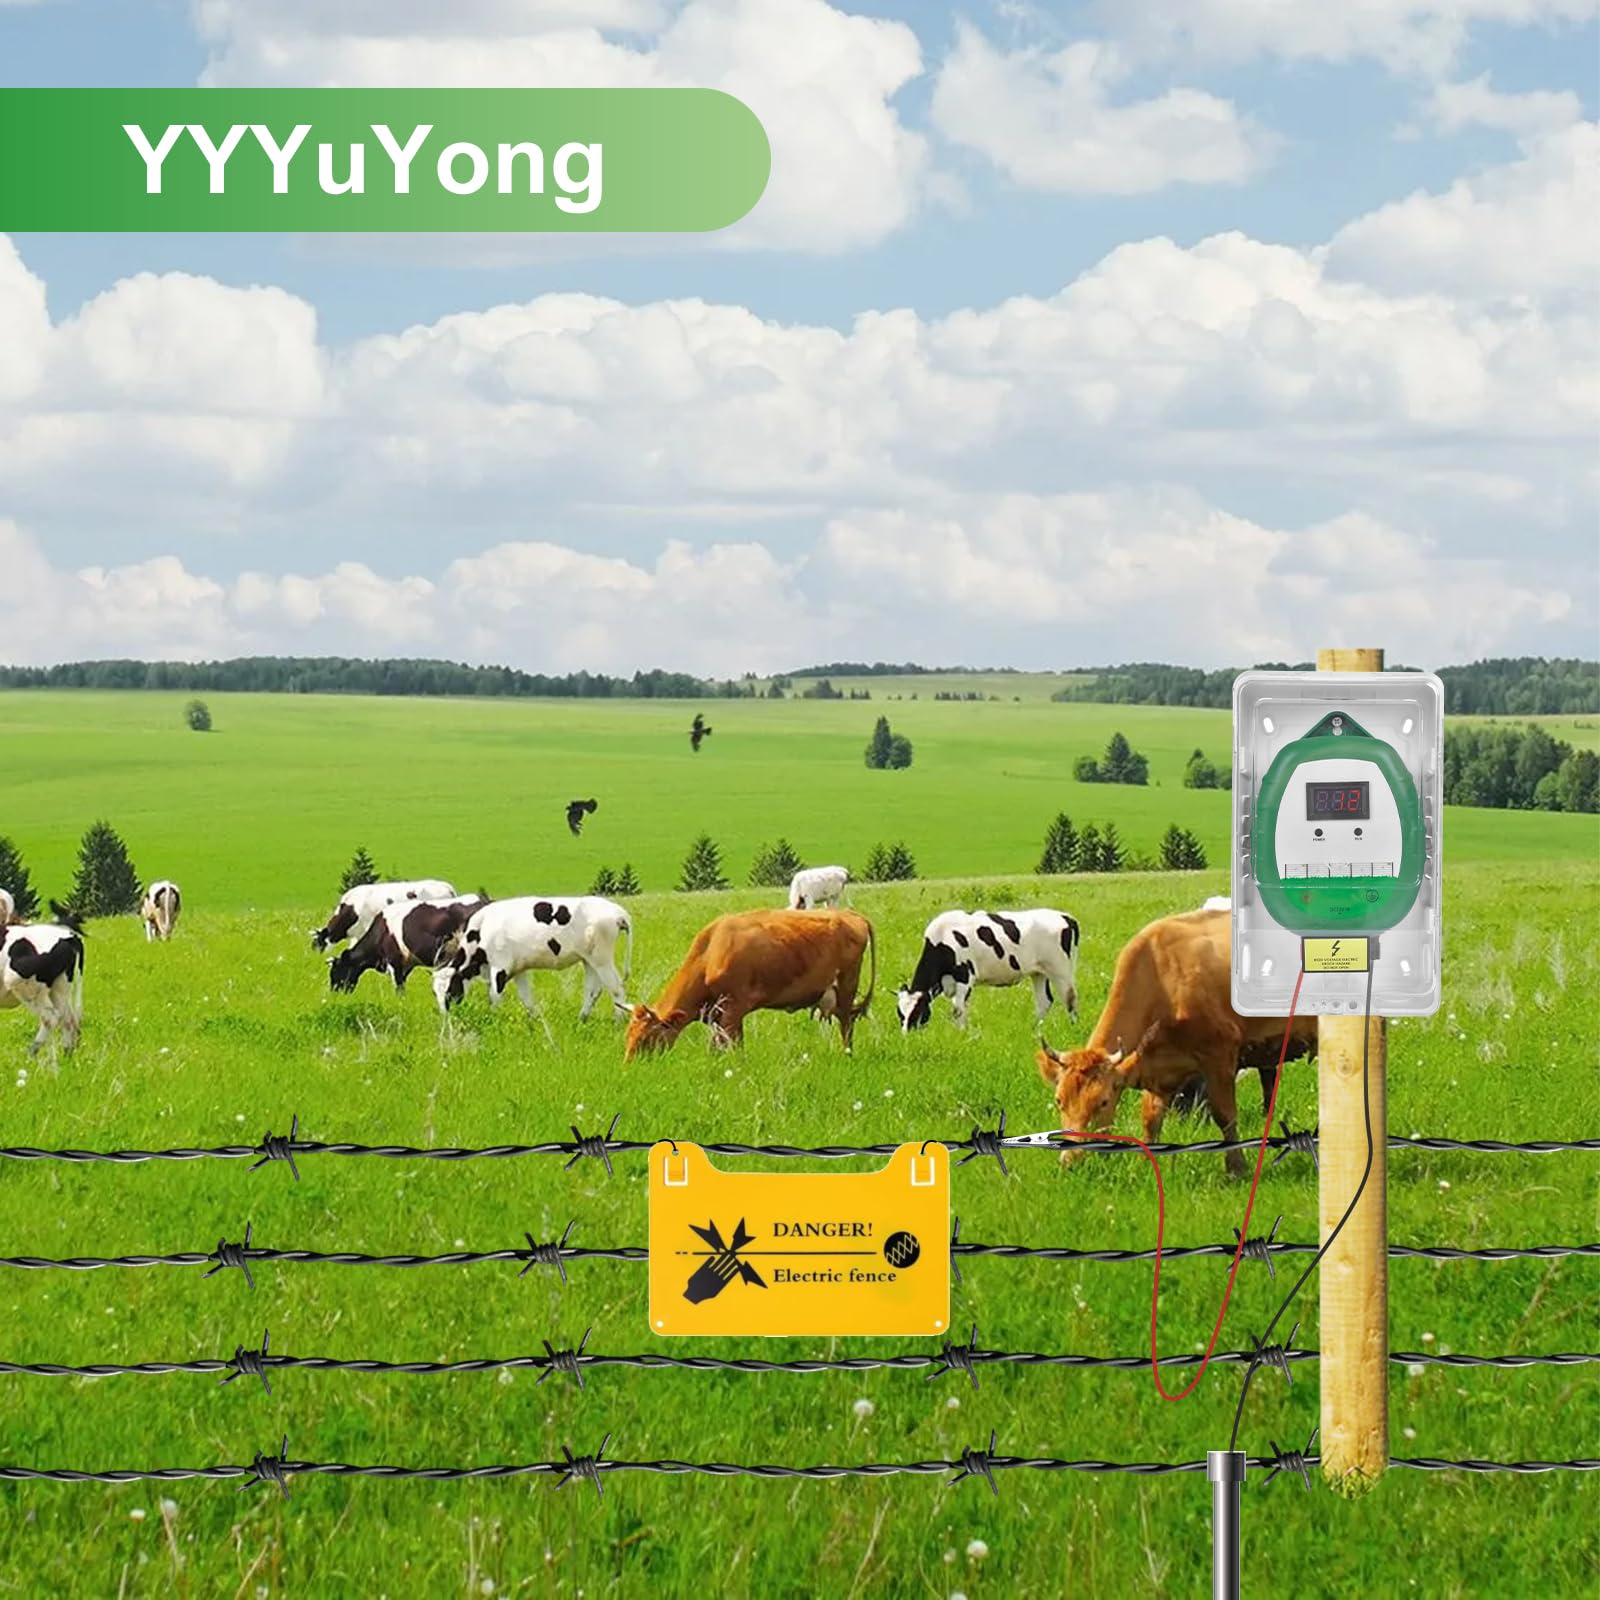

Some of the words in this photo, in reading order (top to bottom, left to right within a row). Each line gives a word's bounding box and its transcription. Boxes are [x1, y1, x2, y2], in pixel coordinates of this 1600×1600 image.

[773, 1222, 873, 1238] DANGER!
[773, 1268, 842, 1283] Electric
[849, 1267, 897, 1283] fence
